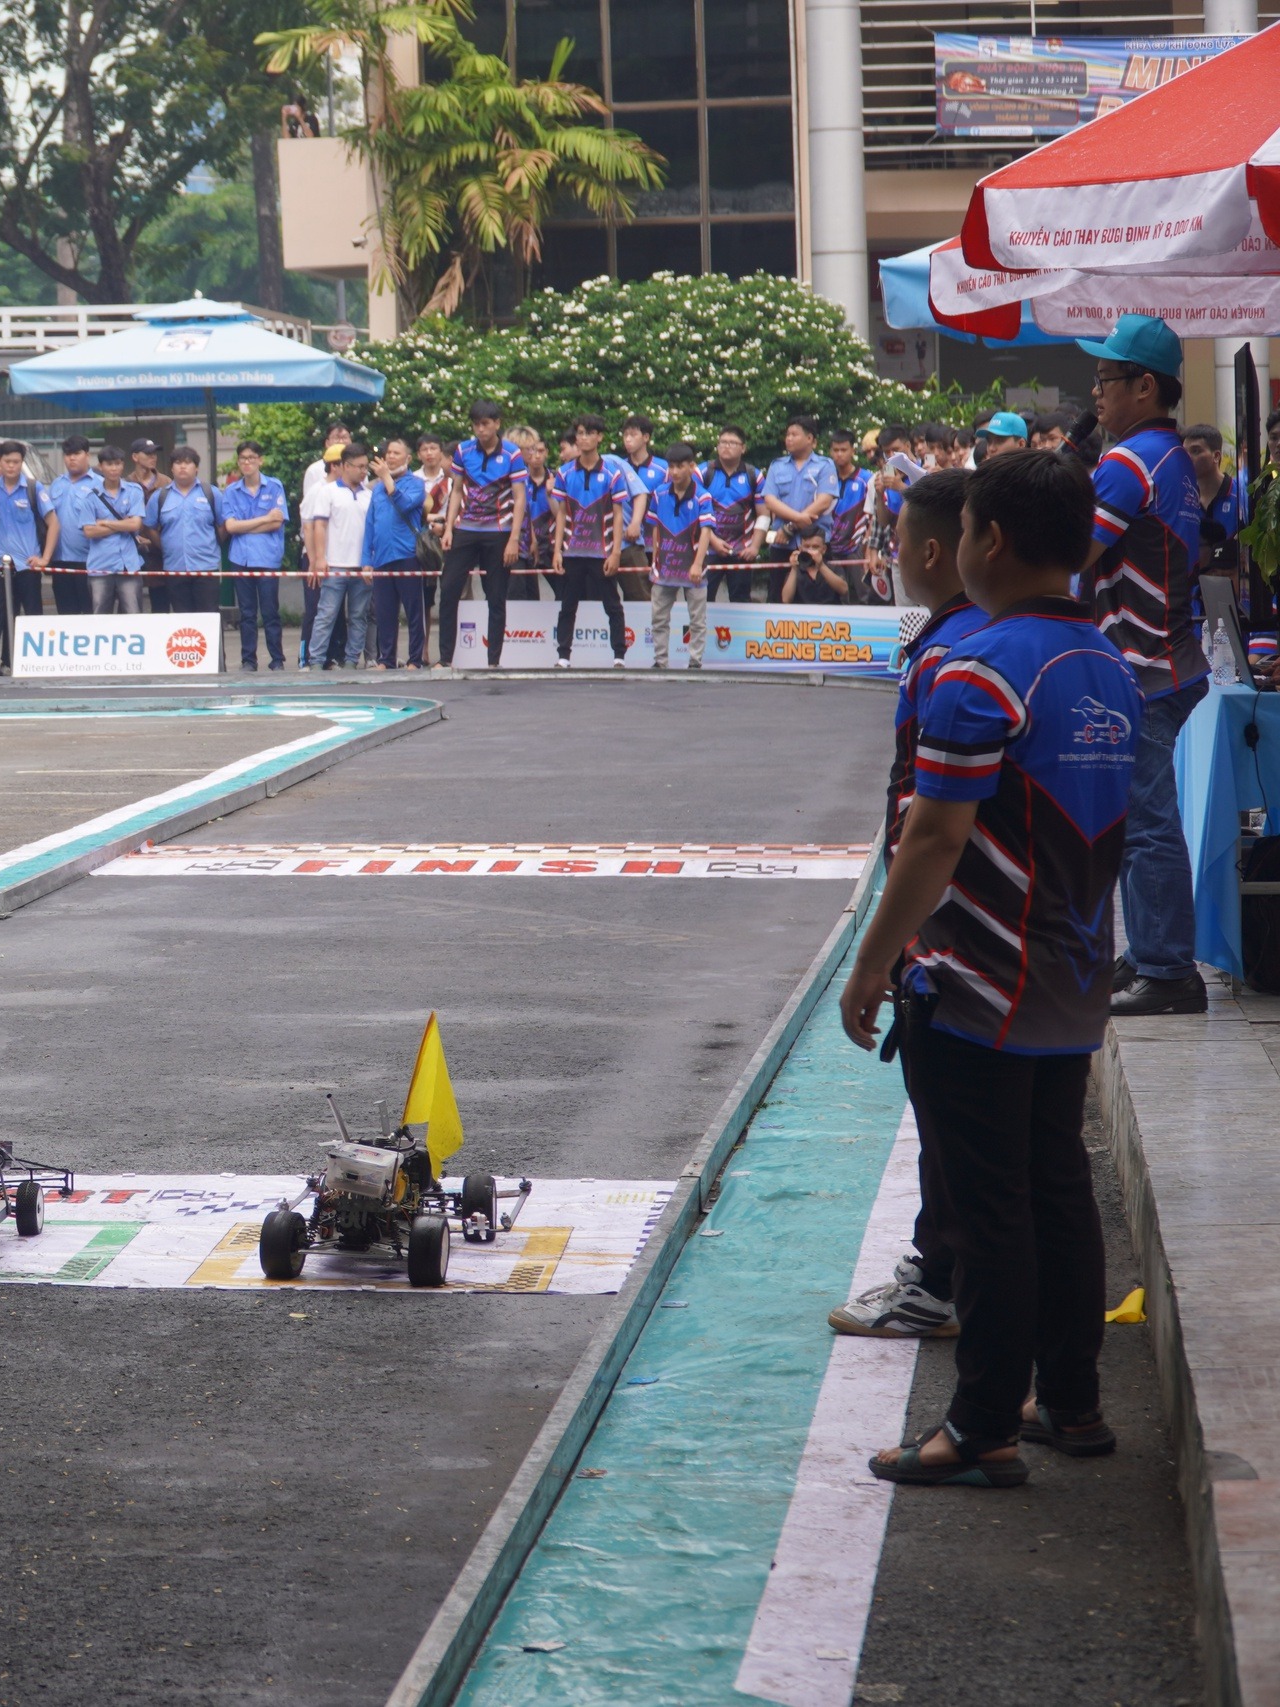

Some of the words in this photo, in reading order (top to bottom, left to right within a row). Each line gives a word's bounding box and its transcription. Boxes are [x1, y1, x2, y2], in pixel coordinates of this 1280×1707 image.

[1009, 226, 1050, 246] KHUYẾN
[1053, 228, 1072, 247] CÁO
[1074, 229, 1100, 245] THAY
[1101, 228, 1123, 244] BUGI
[1125, 225, 1151, 245] ĐỊNH
[1152, 220, 1163, 240] KỲ
[1164, 218, 1187, 239] 8,000
[1188, 215, 1204, 232] KM
[978, 274, 991, 290] CÁO
[993, 272, 1007, 286] THAY
[117, 373, 138, 384] Cao
[218, 371, 238, 382] Cao
[765, 619, 851, 642] MINICAR
[22, 629, 146, 657] Niterra
[171, 635, 201, 647] NGK
[173, 652, 200, 661] BUGI
[745, 640, 816, 661] RACING
[818, 643, 873, 662] 2024
[21, 663, 56, 672] Niterra
[59, 662, 101, 672] Vietnam
[292, 859, 686, 874] FINISH
